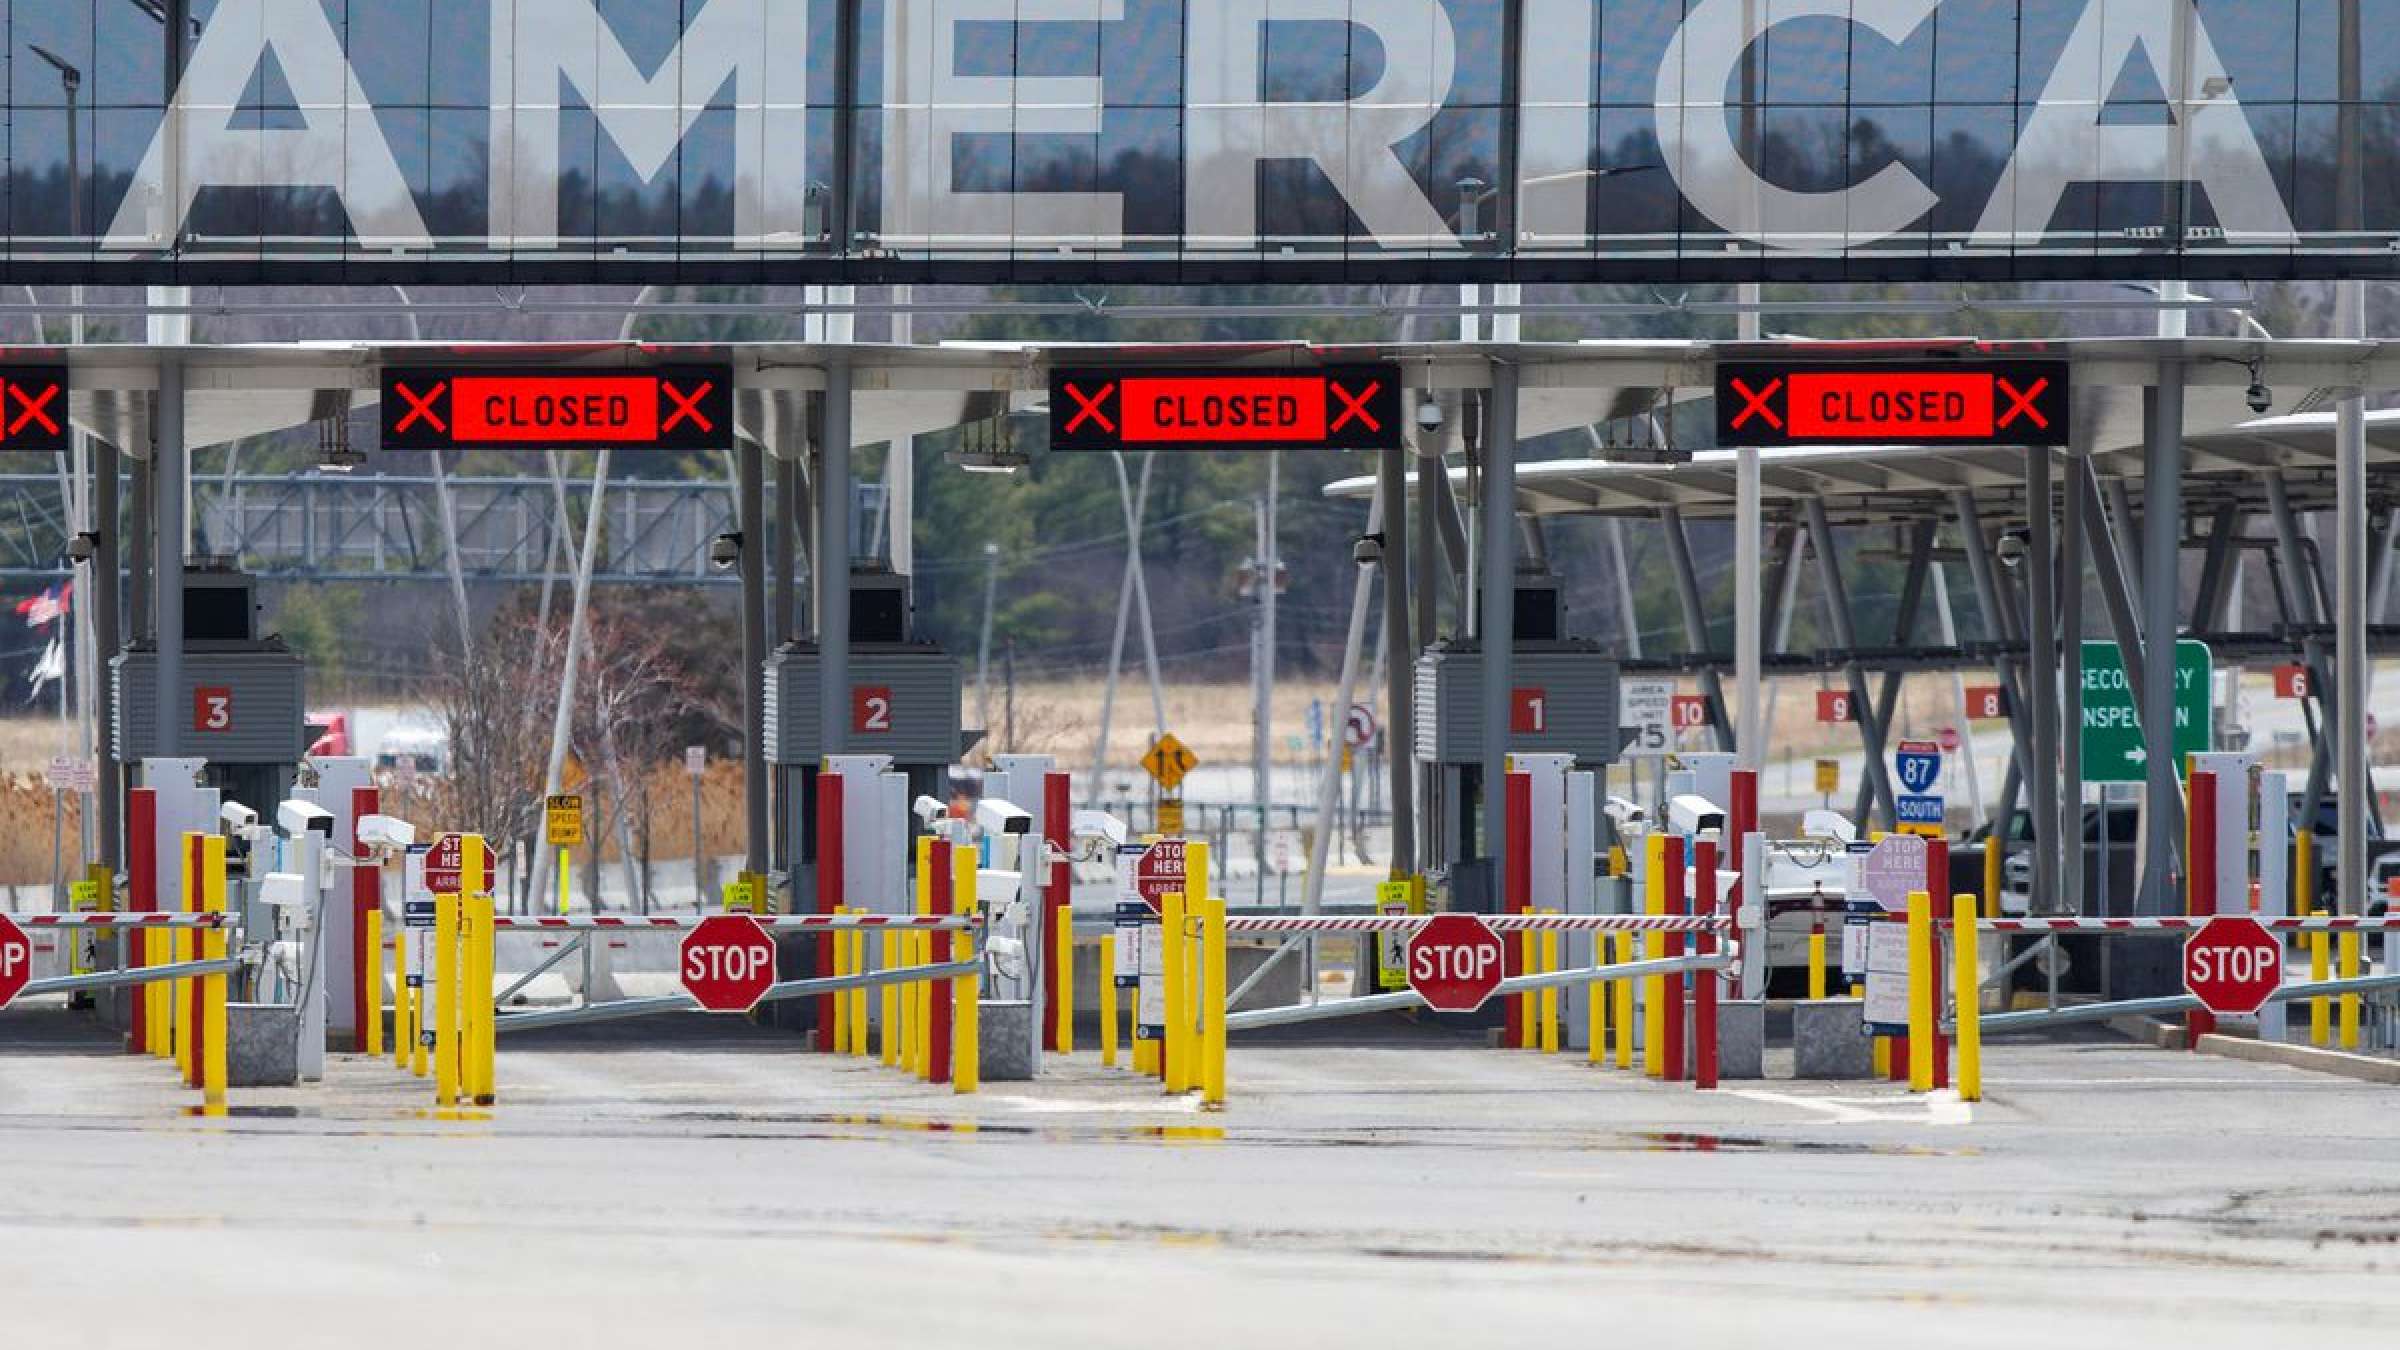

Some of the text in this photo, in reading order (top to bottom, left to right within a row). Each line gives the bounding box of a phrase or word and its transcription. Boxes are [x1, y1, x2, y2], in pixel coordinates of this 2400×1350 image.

[100, 0, 2301, 250] AMERICA
[484, 394, 629, 427] CLOSED
[1153, 394, 1298, 427] CLOSED
[1821, 390, 1966, 422] CLOSED
[2293, 672, 2306, 696] 6
[207, 697, 229, 728] 3
[865, 697, 889, 728] 2
[1528, 698, 1544, 730] 1
[1678, 700, 1702, 725] 10
[1833, 698, 1848, 720] 9
[1984, 695, 1999, 717] 8
[1905, 757, 1931, 784] 87
[1900, 801, 1942, 817] SOUTH
[1883, 855, 1921, 869] HERE
[686, 945, 769, 981] STOP
[1414, 944, 1497, 981] STOP
[2191, 946, 2275, 982] STOP
